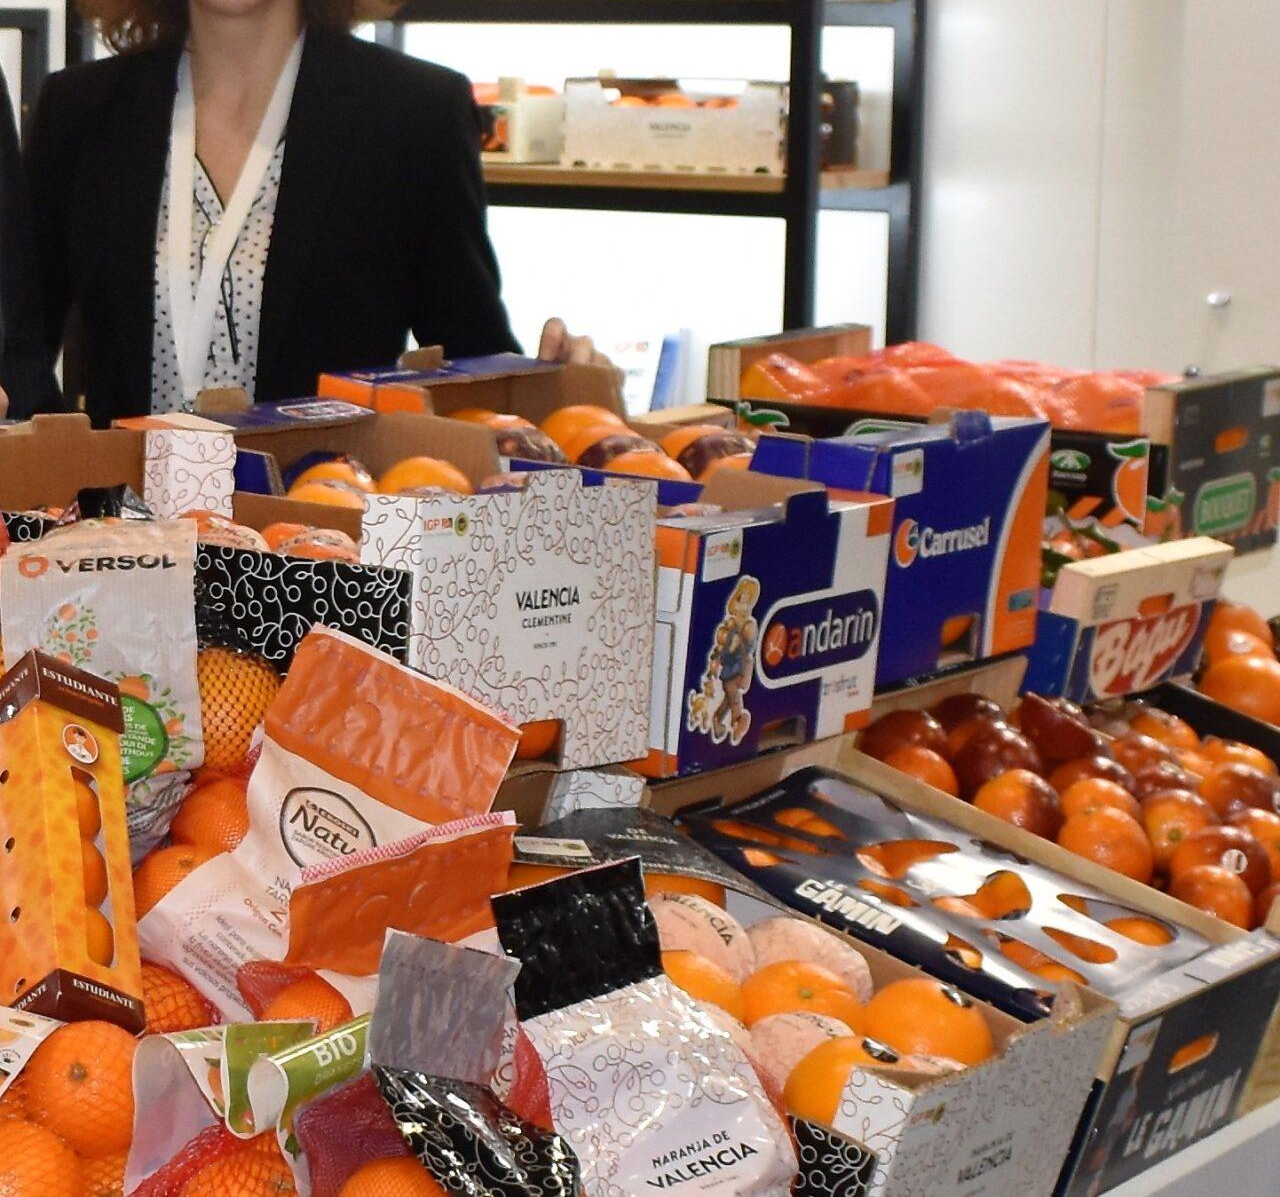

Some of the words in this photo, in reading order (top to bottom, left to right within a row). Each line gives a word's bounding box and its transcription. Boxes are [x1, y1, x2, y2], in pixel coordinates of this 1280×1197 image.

[920, 516, 992, 559] Carrusel
[55, 554, 177, 574] VERSOL
[515, 585, 581, 611] VALENCIA
[521, 612, 572, 630] CLEMENTINE
[41, 667, 120, 707] ESTUDIANTE
[72, 978, 136, 1010] ESTUDIANTE
[313, 1033, 358, 1067] BIO
[646, 1142, 759, 1189] VALENCIA
[651, 1138, 712, 1169] NARANJA
[712, 1130, 731, 1145] DE
